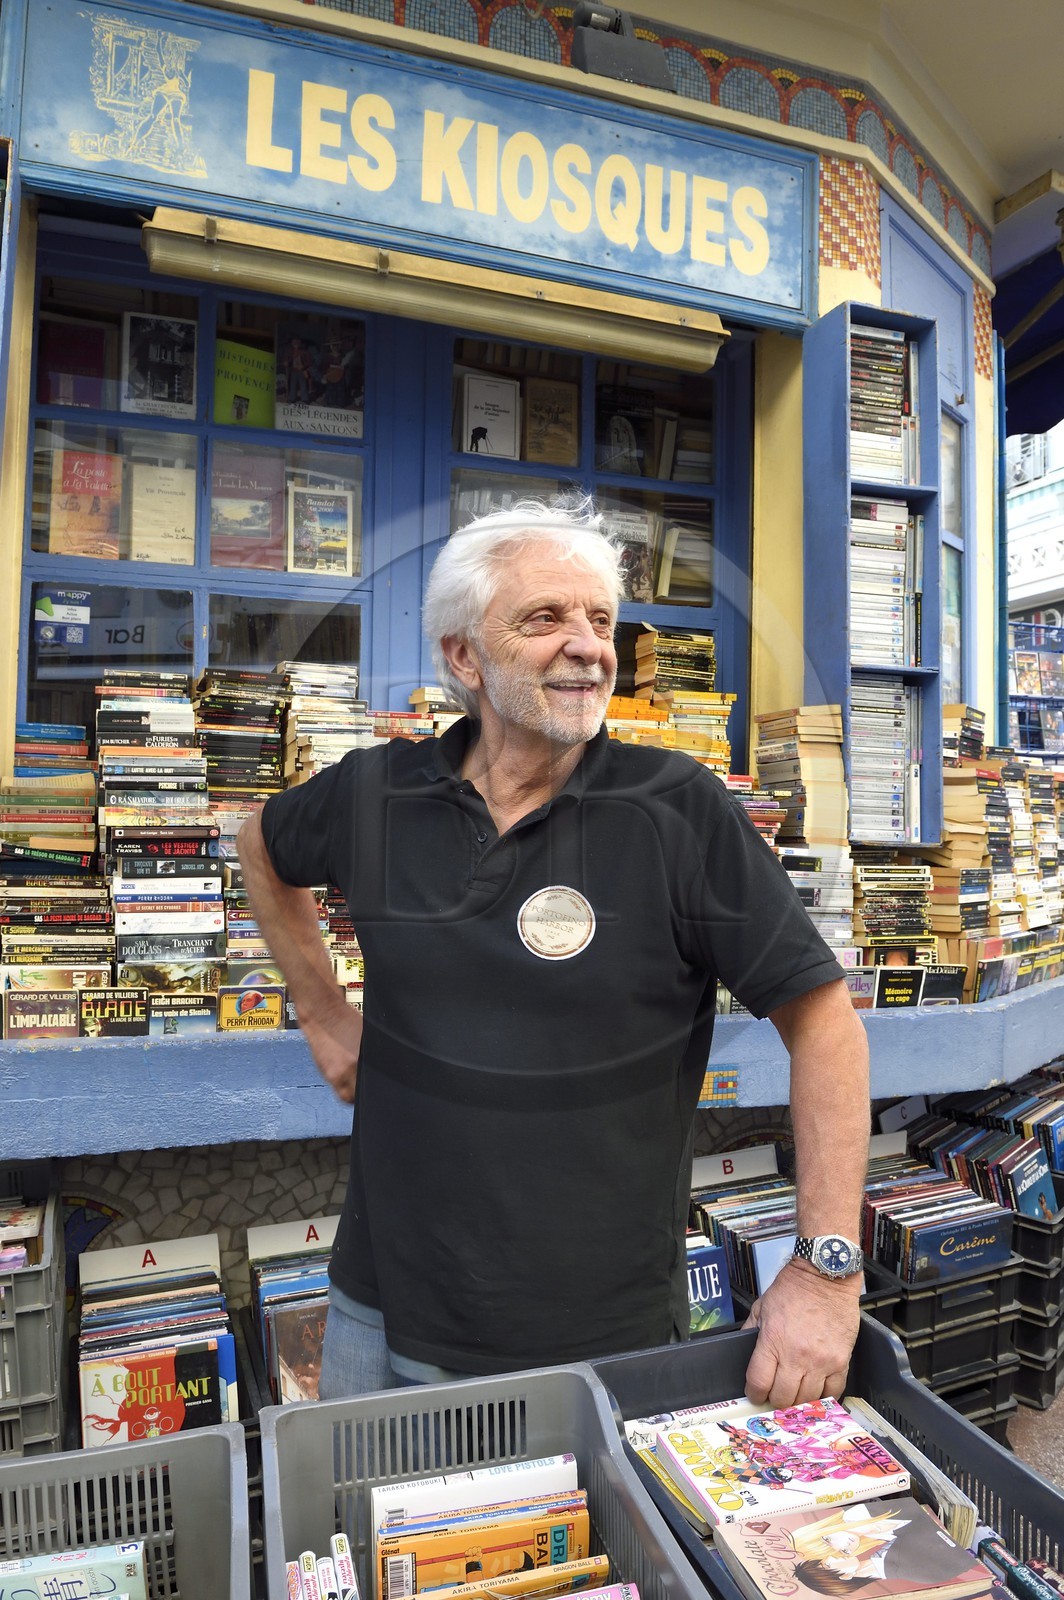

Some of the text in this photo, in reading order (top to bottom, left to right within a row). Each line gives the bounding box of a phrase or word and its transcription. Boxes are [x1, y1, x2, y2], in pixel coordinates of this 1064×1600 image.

[245, 68, 770, 276] LES KIOSQUES
[219, 350, 274, 371] HISTOIRES
[217, 369, 272, 390] PROVENCE
[282, 407, 358, 423] DES LÉGENDES
[283, 420, 358, 435] AUX SANTONS
[307, 498, 335, 507] Bandol
[531, 905, 586, 927] PORTOFINO
[536, 916, 574, 933] HARBOR
[122, 944, 162, 956] DOUGLASS
[172, 939, 214, 948] TRANCHANT
[115, 991, 139, 999] VILLIERS
[142, 991, 147, 1000] 1
[885, 987, 913, 995] Mémoire
[896, 996, 910, 1004] cage
[82, 1000, 147, 1018] BLADE
[152, 1010, 163, 1018] Les
[164, 1010, 178, 1018] voix
[10, 1014, 76, 1028] L'IMPLACABLE
[226, 1016, 274, 1026] PERRY RHODAN
[901, 1107, 908, 1119] C
[722, 1158, 734, 1175] B
[305, 1224, 320, 1242] A
[939, 1234, 996, 1256] Carême
[141, 1249, 157, 1268] A
[91, 1367, 161, 1396] À BOUT
[124, 1376, 212, 1409] PORTANT
[675, 1402, 730, 1417] CHONCHU
[852, 1436, 901, 1473] CLAMP
[488, 1457, 556, 1476] LOVE PISTOLS
[667, 1432, 744, 1511] CLAMP
[378, 1478, 442, 1493] TARAKO KOTOBUKI
[463, 1505, 501, 1515] TORIYAMA
[485, 1508, 518, 1517] TORIYAMA
[528, 1502, 556, 1510] DRAGON
[433, 1530, 457, 1538] AKIRA
[460, 1524, 499, 1533] TORIYAMA
[121, 1542, 139, 1553] 3
[380, 1548, 400, 1556] Glénat
[744, 1540, 800, 1597] Chocolate
[452, 1560, 592, 1594] AKIRA TORIYAMA DRAGON BALL
